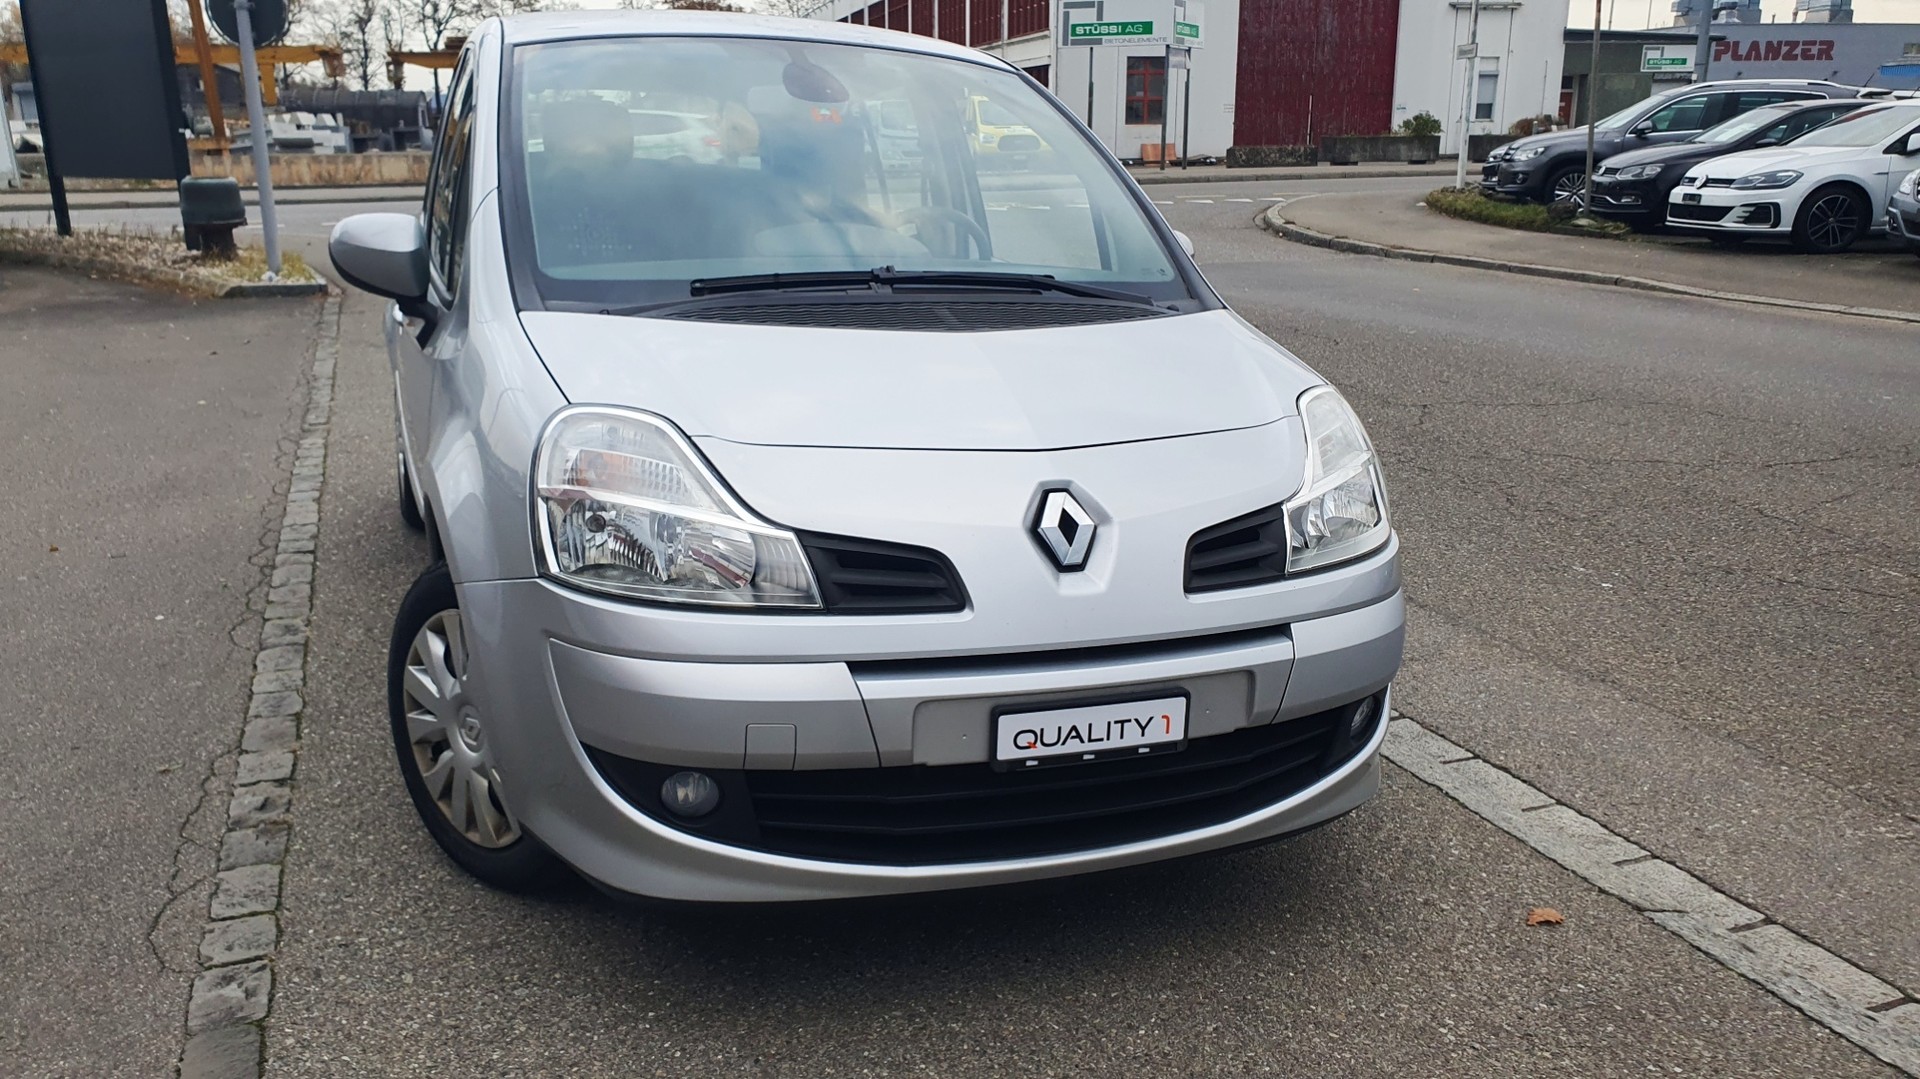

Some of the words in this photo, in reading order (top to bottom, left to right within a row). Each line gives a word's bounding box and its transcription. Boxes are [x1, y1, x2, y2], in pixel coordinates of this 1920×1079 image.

[1075, 23, 1122, 35] STÜSSI
[1125, 24, 1143, 33] AG
[1104, 36, 1168, 44] BETONELEMENTE
[1713, 39, 1835, 62] PLANZER
[1013, 716, 1154, 750] QUALITY
[1161, 714, 1171, 735] 1
